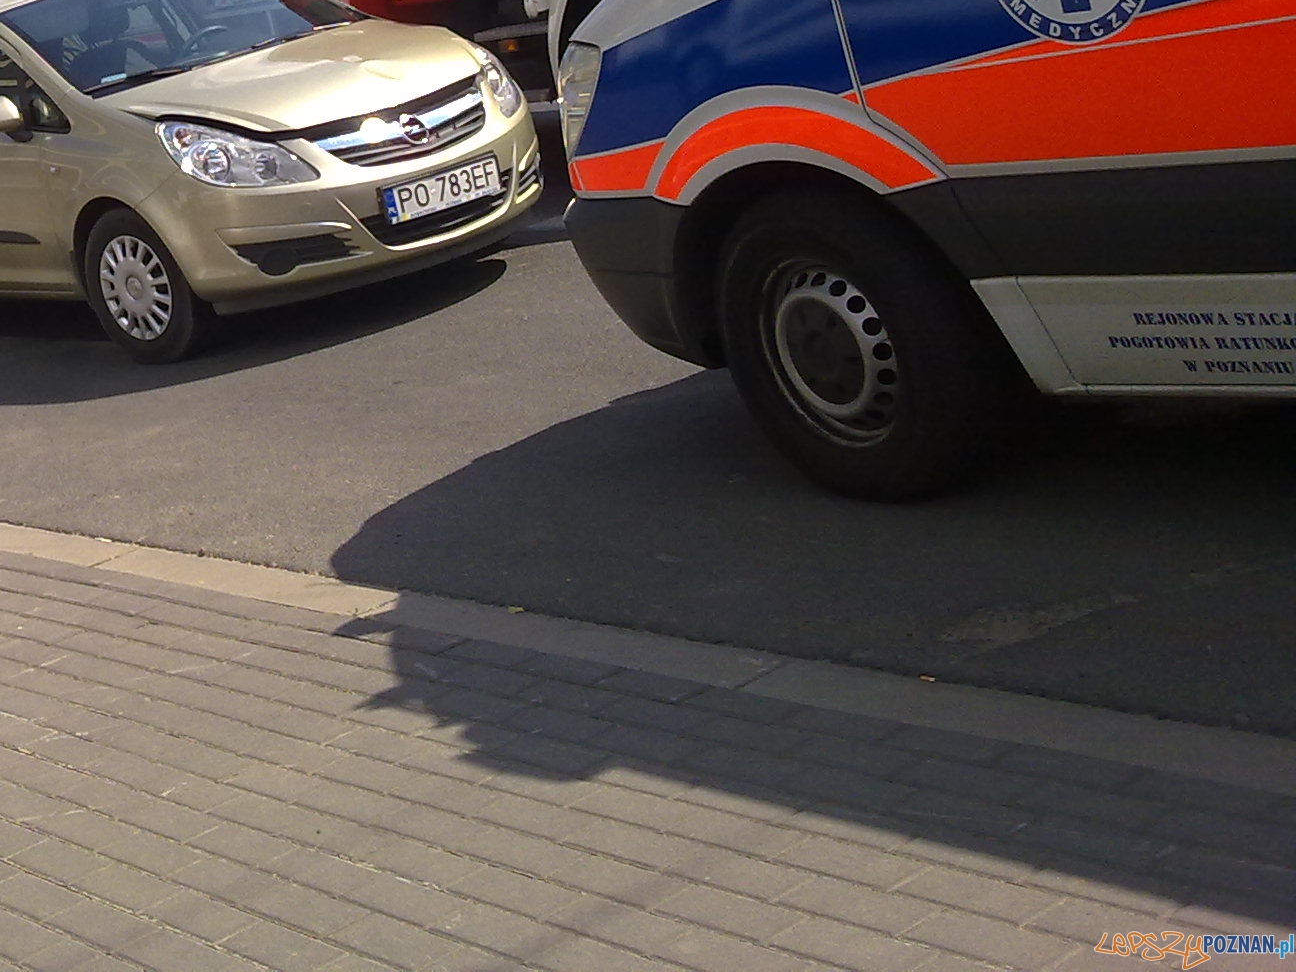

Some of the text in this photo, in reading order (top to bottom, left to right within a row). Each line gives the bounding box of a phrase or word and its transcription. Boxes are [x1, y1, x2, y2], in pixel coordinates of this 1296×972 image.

[397, 160, 494, 213] PO 783EF
[1133, 312, 1296, 326] REJONOWA STACJ
[1108, 336, 1211, 350] POGOTOWIA
[1182, 360, 1198, 373] W
